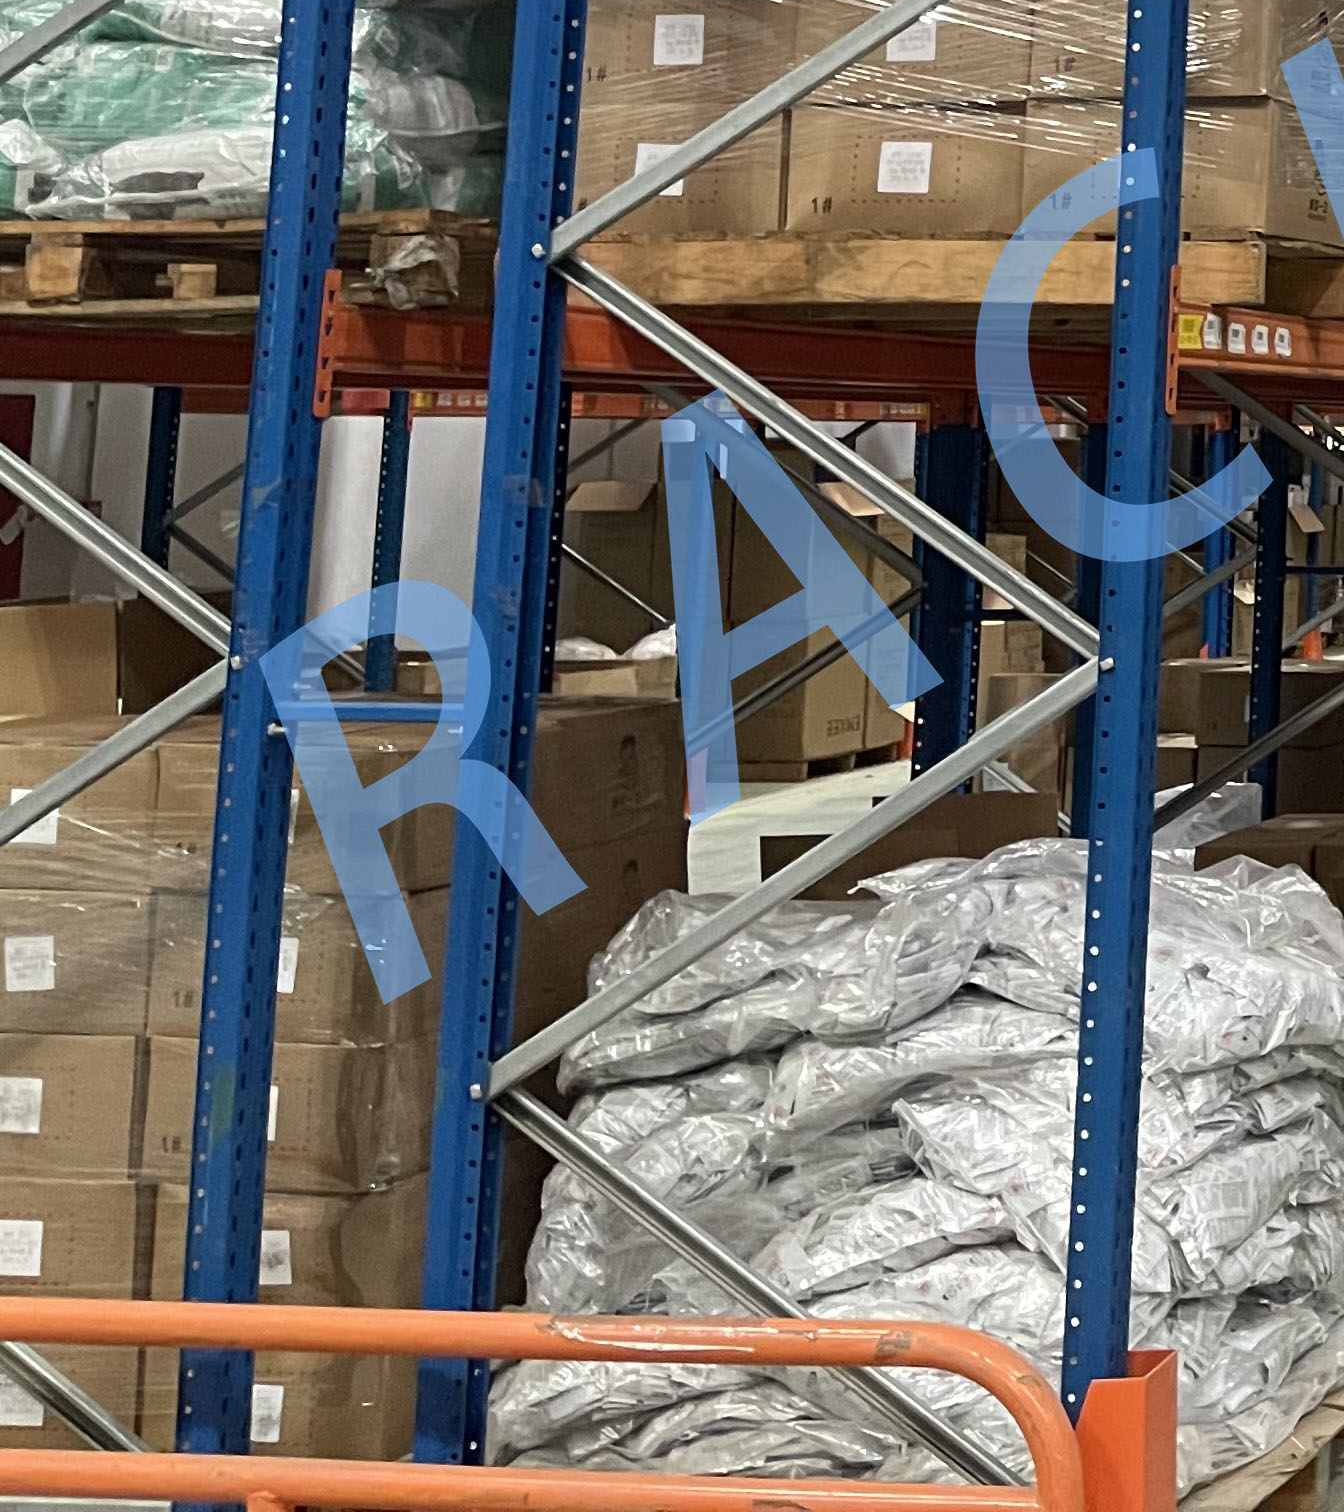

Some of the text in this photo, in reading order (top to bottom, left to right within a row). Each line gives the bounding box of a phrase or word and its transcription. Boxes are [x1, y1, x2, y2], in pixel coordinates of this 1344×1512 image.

[811, 197, 832, 214] 1#
[173, 991, 194, 1008] 1#
[161, 1136, 182, 1153] 1#
